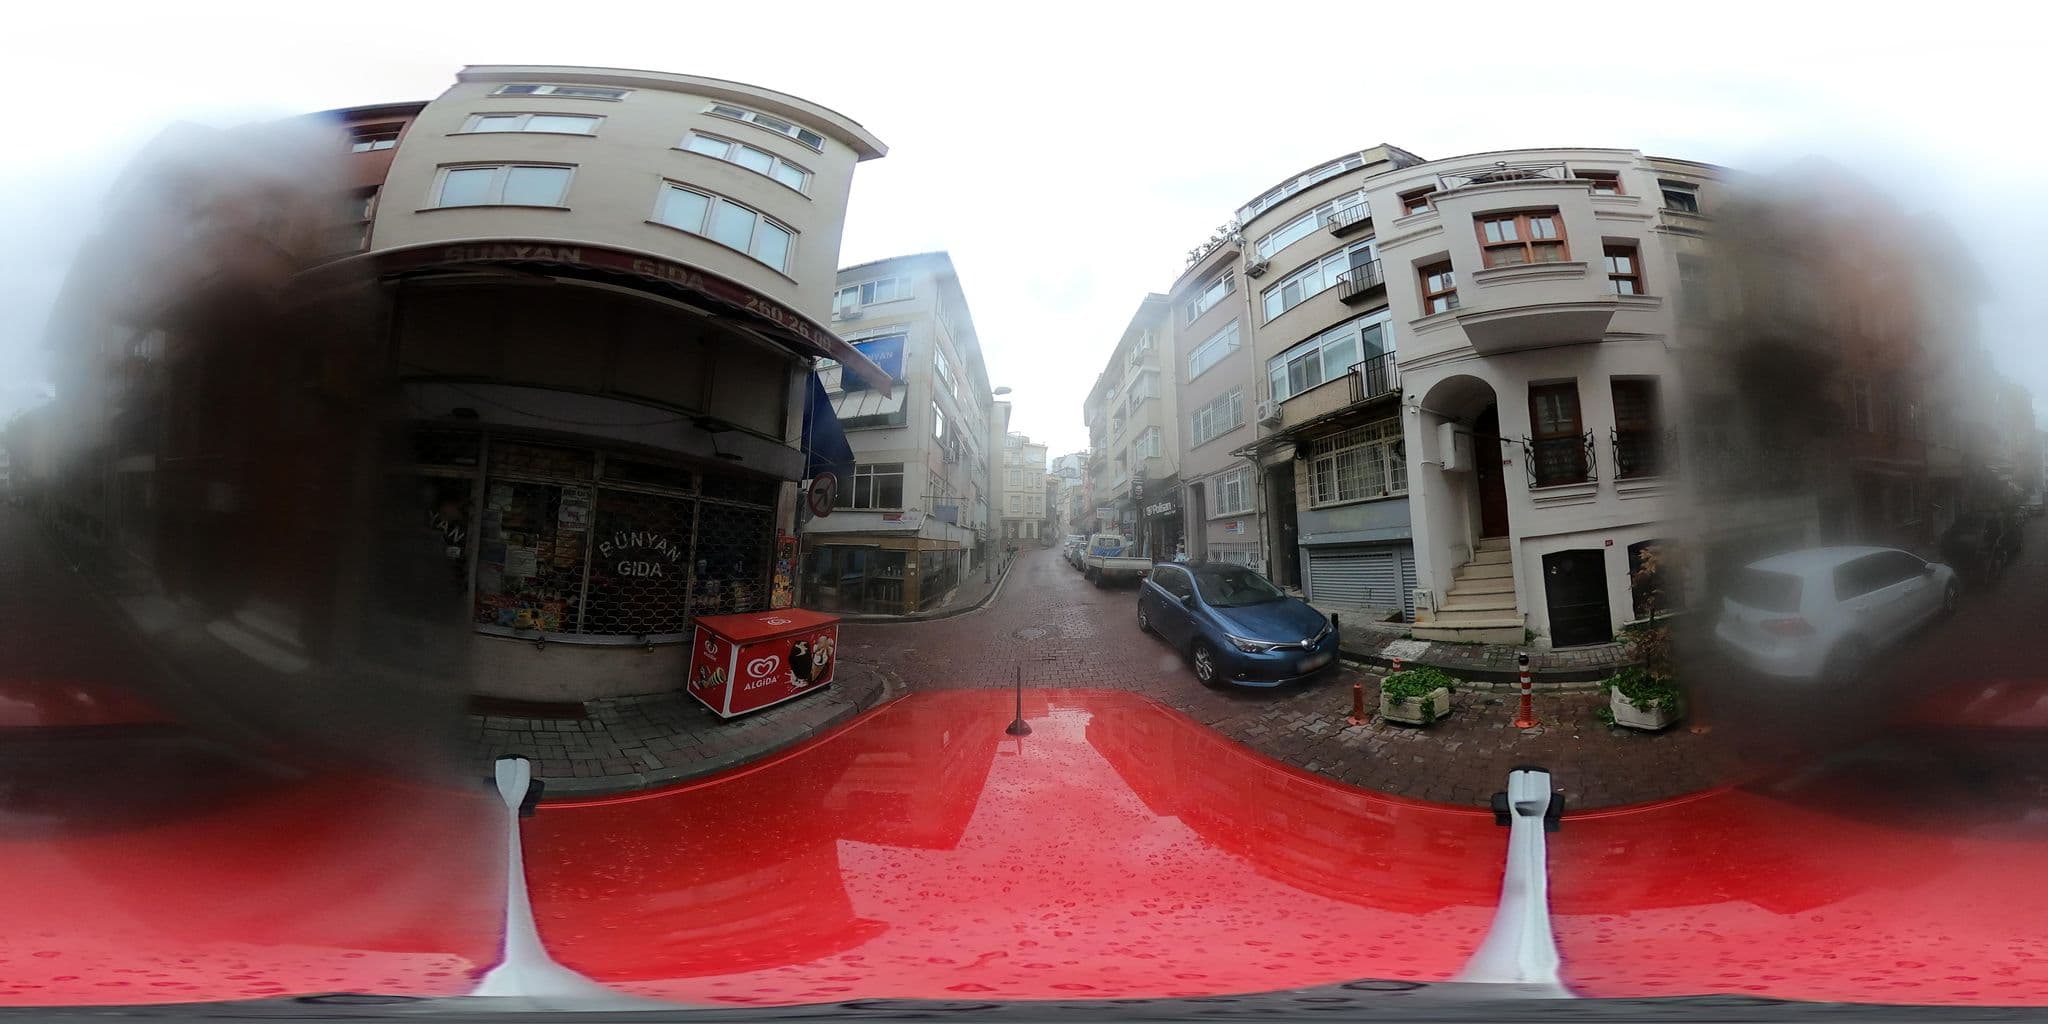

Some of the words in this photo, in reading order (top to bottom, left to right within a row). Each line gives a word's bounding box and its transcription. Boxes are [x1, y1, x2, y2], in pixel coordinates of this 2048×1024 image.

[788, 314, 809, 337] 26
[429, 510, 466, 544] YAN
[599, 531, 681, 562] BÜNYAN
[617, 560, 663, 578] GIDA
